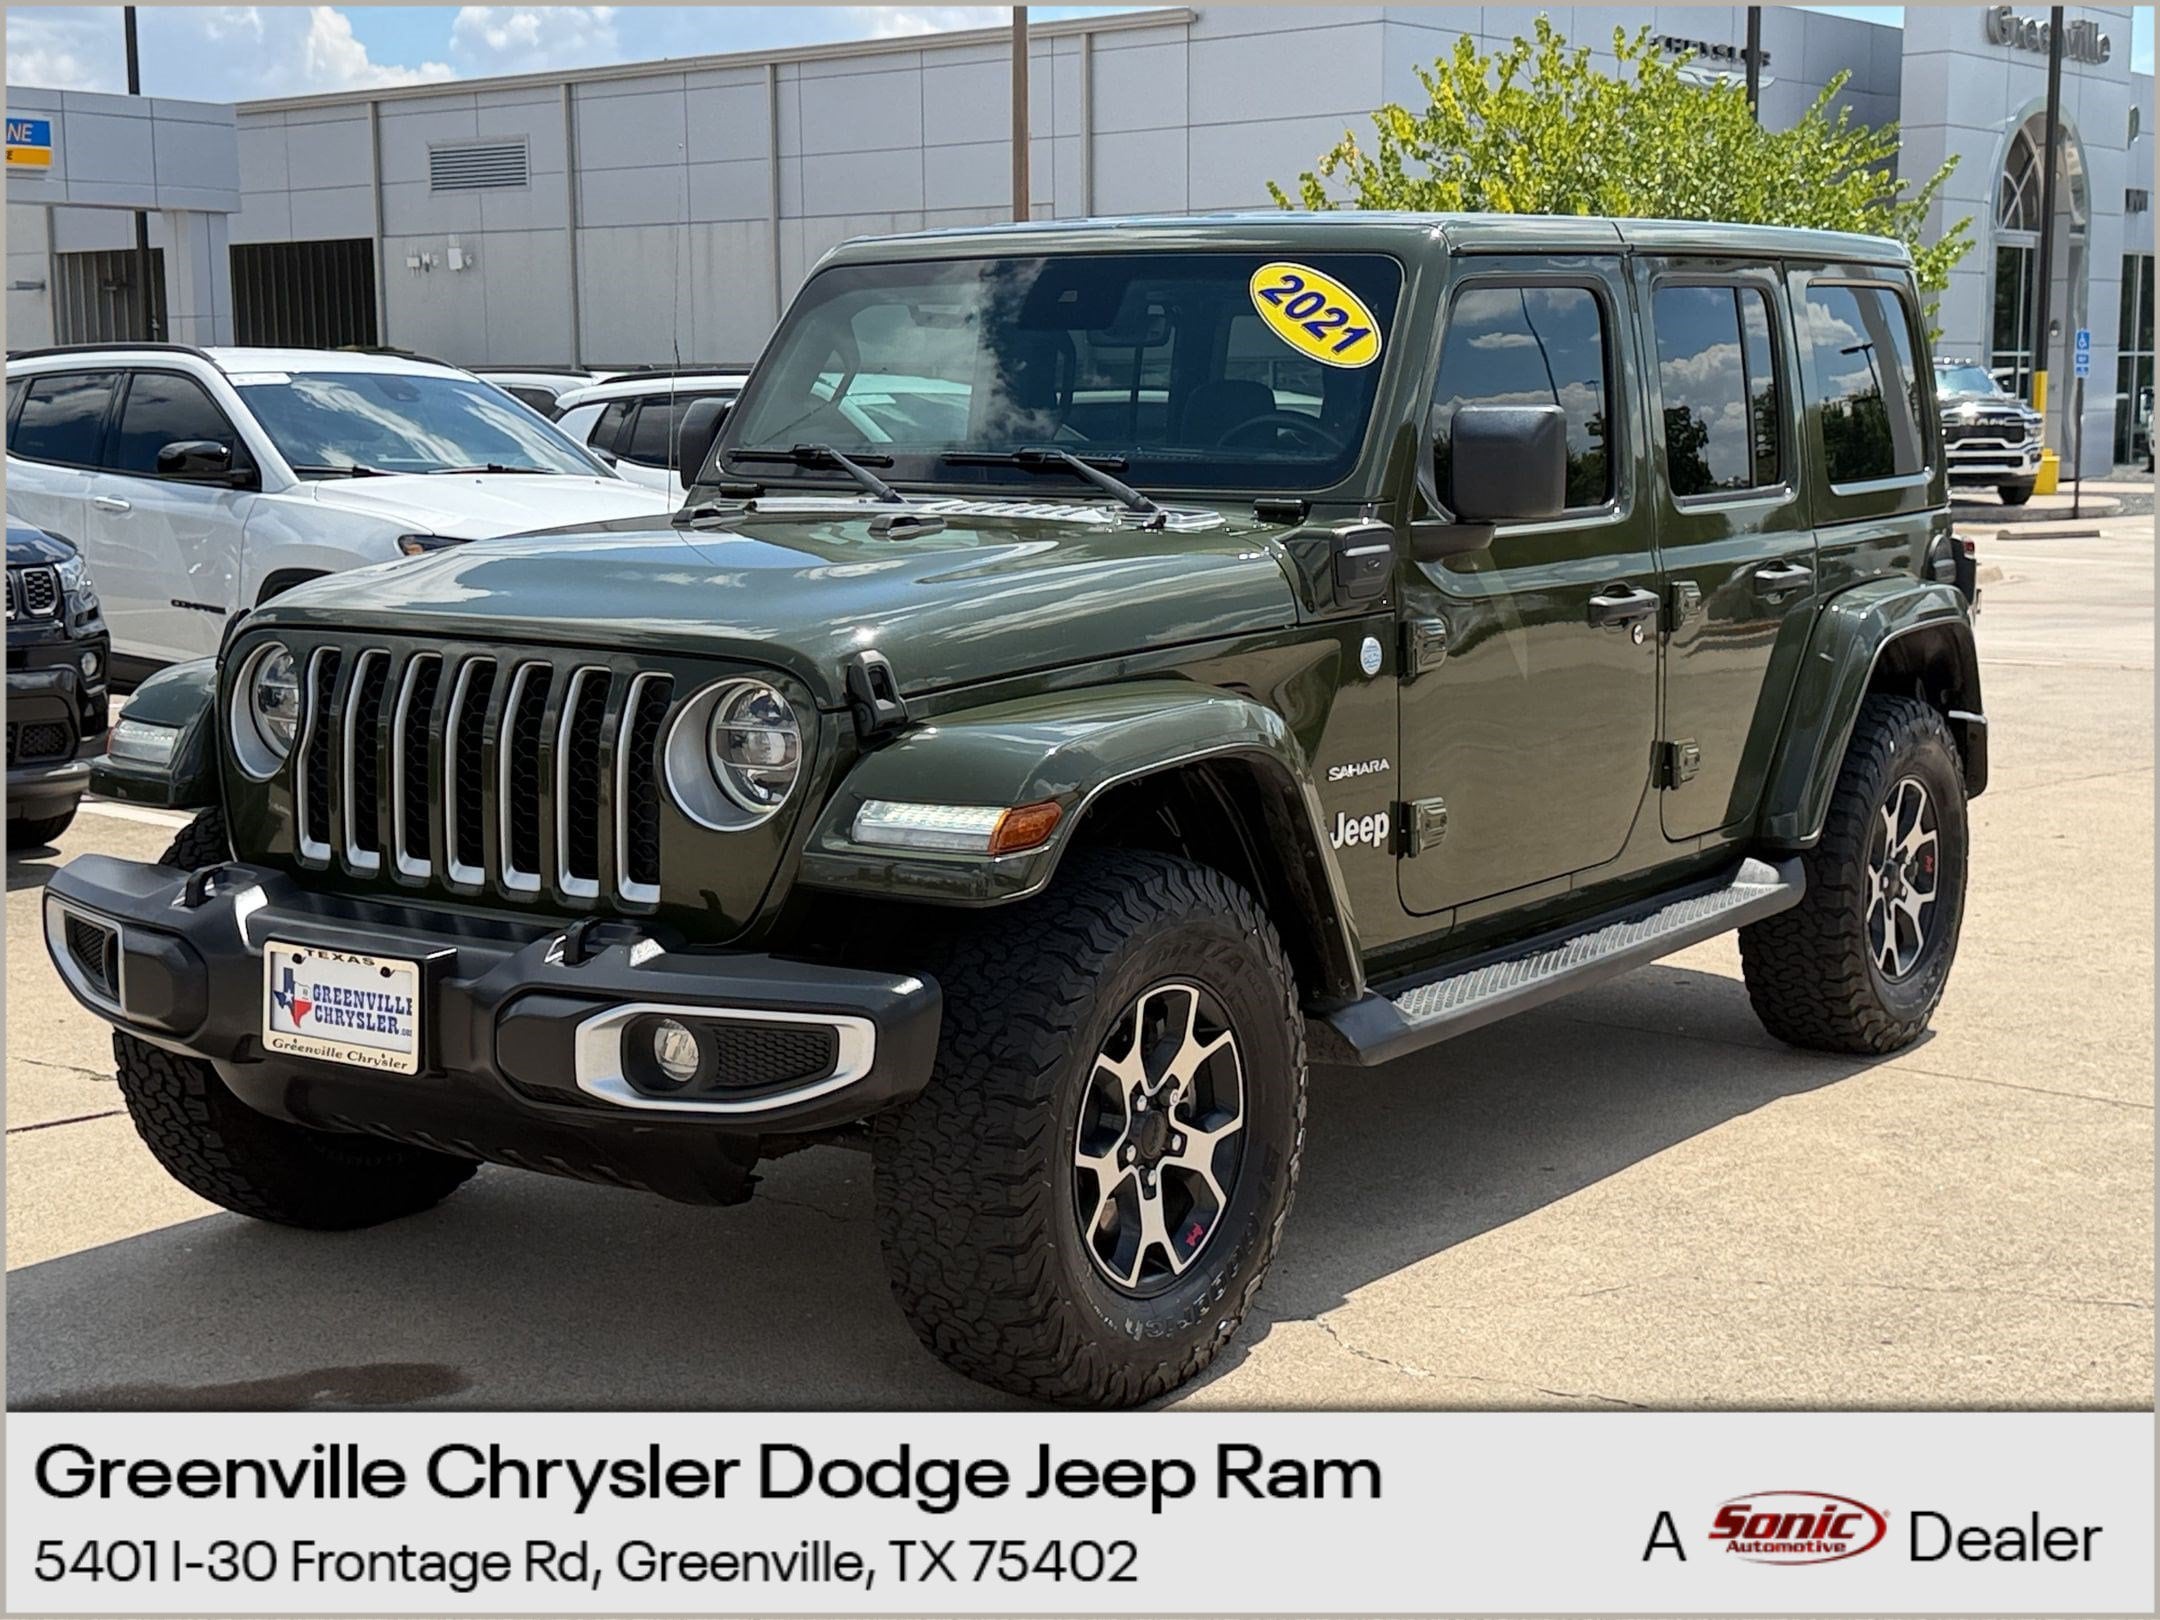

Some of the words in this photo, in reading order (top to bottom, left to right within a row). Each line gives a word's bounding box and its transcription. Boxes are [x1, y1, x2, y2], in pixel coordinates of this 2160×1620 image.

[1258, 275, 1371, 355] 2021
[1328, 758, 1390, 781] SAHARA
[1330, 811, 1390, 850] Jeep
[304, 948, 376, 966] TEXAS
[272, 1038, 343, 1060] Greenville
[347, 1050, 408, 1070] Chrysler
